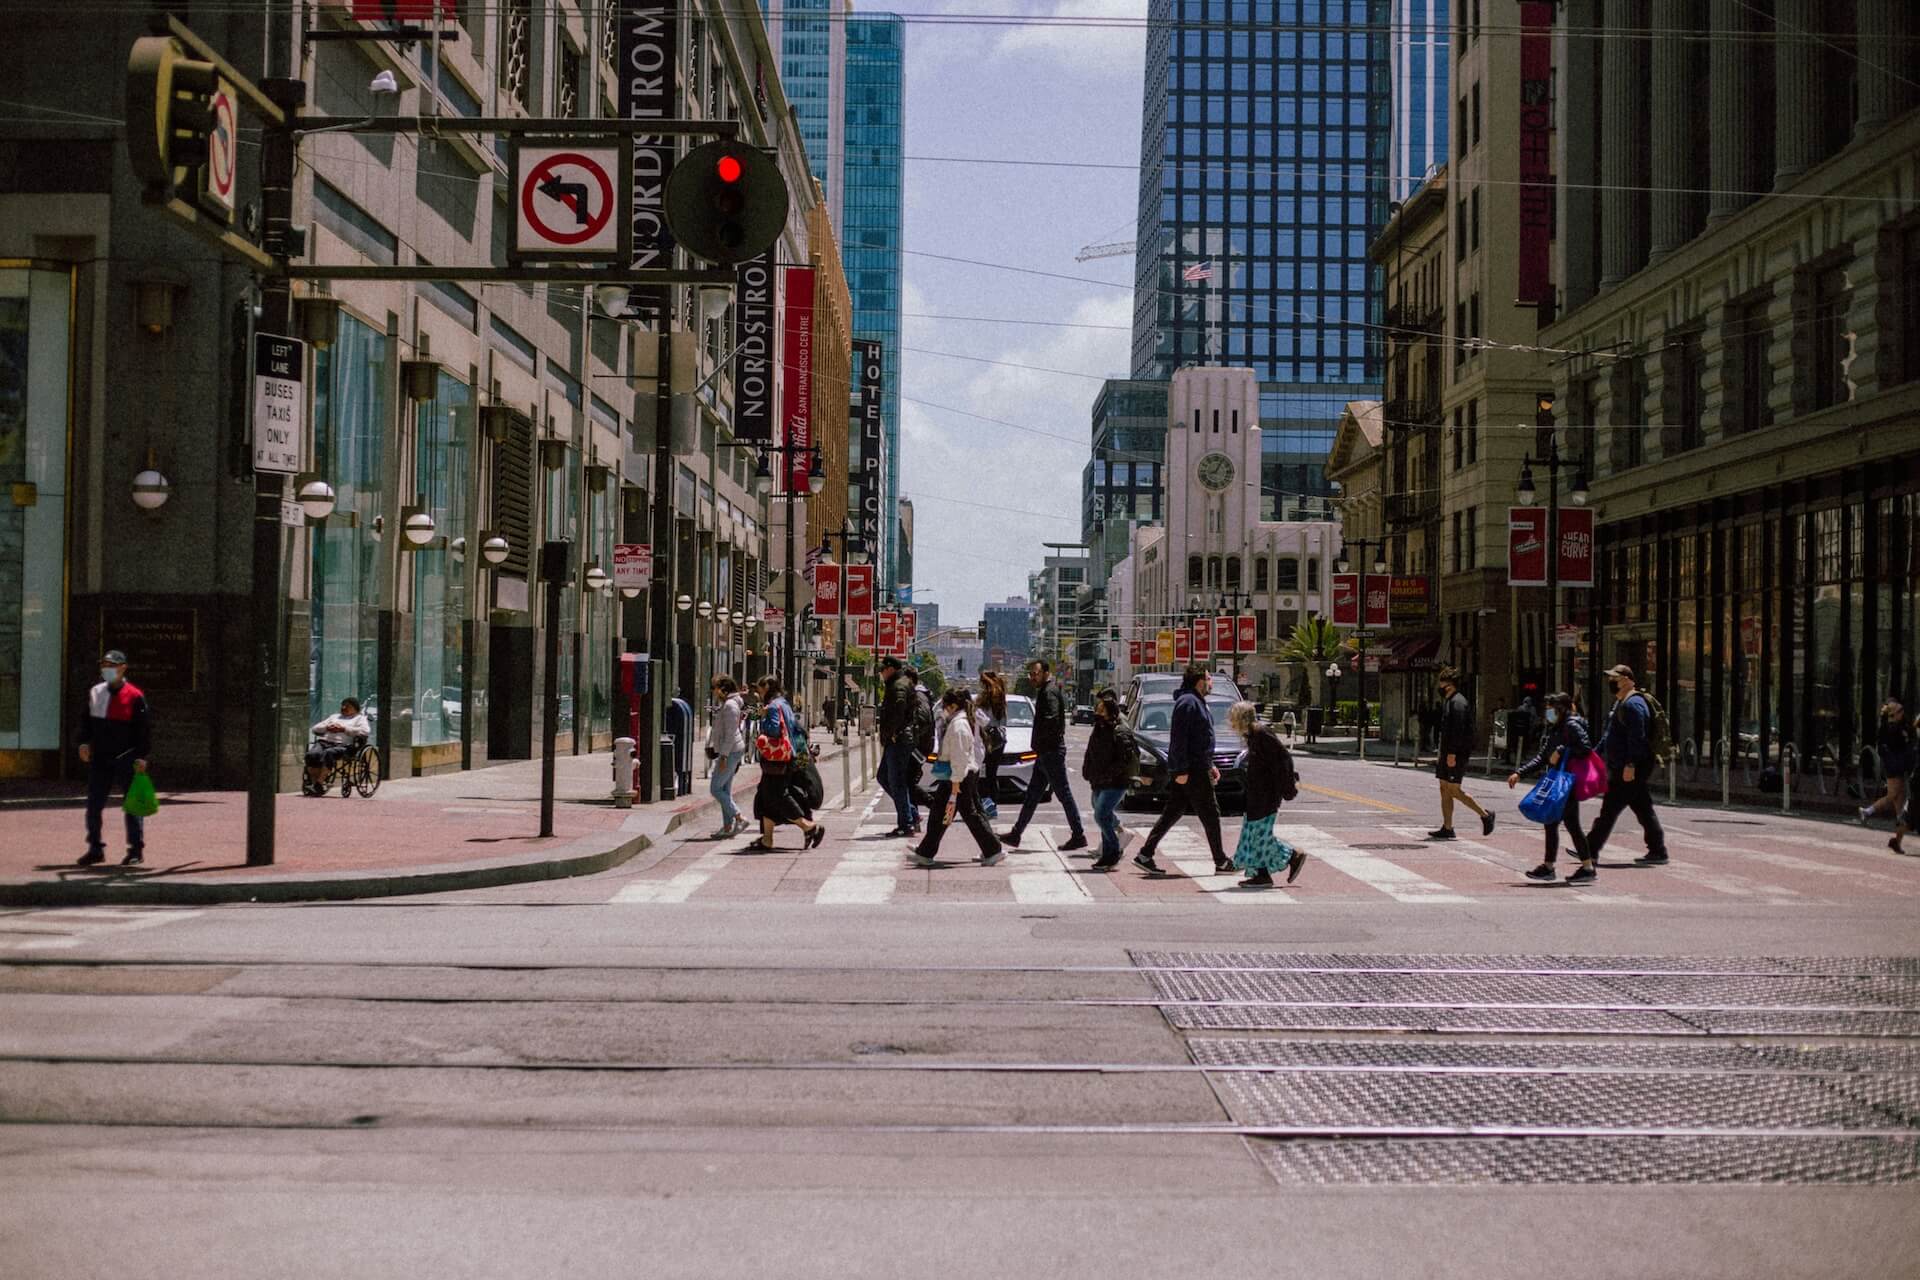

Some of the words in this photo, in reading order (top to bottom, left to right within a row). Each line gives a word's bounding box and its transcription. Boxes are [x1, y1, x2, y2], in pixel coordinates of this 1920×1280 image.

[630, 6, 665, 271] NORDSTROM
[799, 315, 810, 348] CENTRE
[271, 344, 288, 357] LEFT
[271, 361, 289, 374] LANE
[798, 349, 809, 396] FRANCISCO
[264, 382, 293, 400] BUSES
[866, 345, 880, 438] HOTEL
[266, 405, 291, 422] TAXIS
[798, 397, 808, 414] SAN
[266, 428, 289, 445] ONLY
[790, 414, 807, 472] Wetfield
[1561, 544, 1589, 559] CURVE
[616, 567, 629, 575] ANY
[632, 567, 649, 576] TIME
